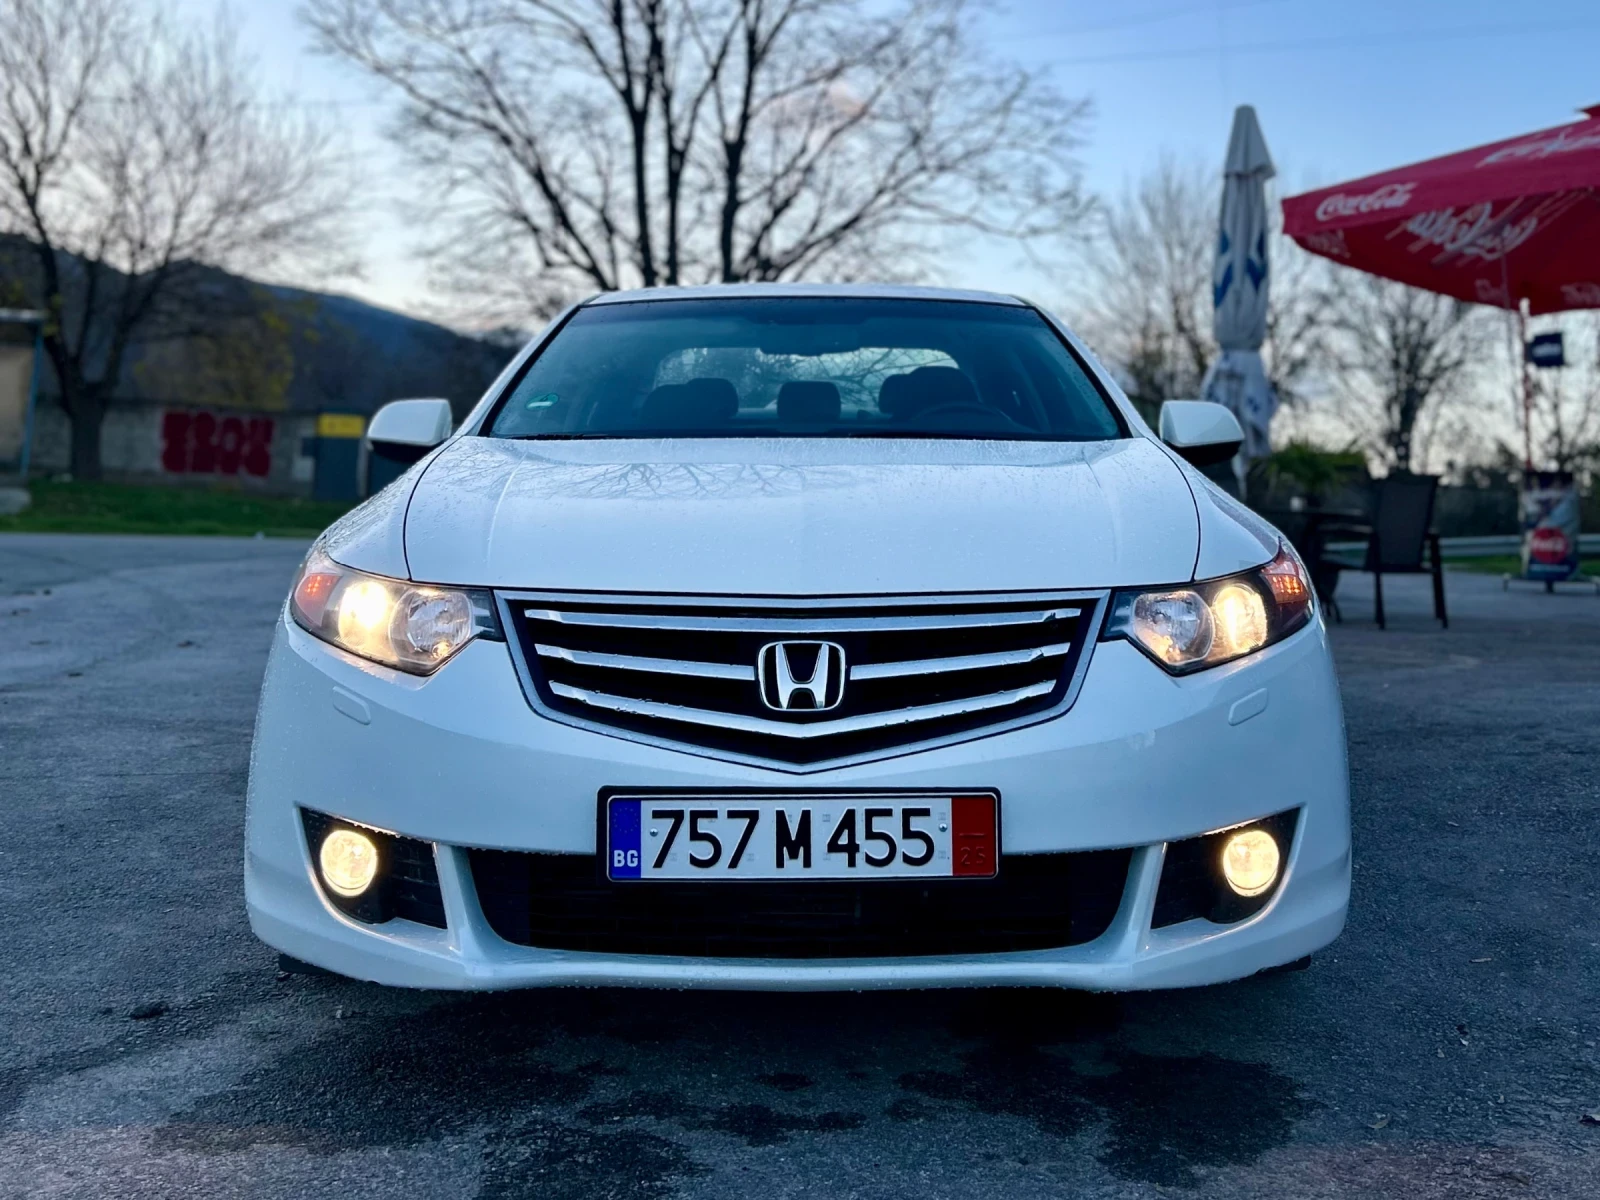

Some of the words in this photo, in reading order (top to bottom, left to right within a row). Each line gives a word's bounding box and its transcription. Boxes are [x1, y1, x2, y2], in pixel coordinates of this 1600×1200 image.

[651, 808, 760, 869] 757
[775, 808, 812, 869] M
[826, 807, 936, 868] 455
[612, 848, 639, 868] BG
[960, 846, 986, 865] 25
